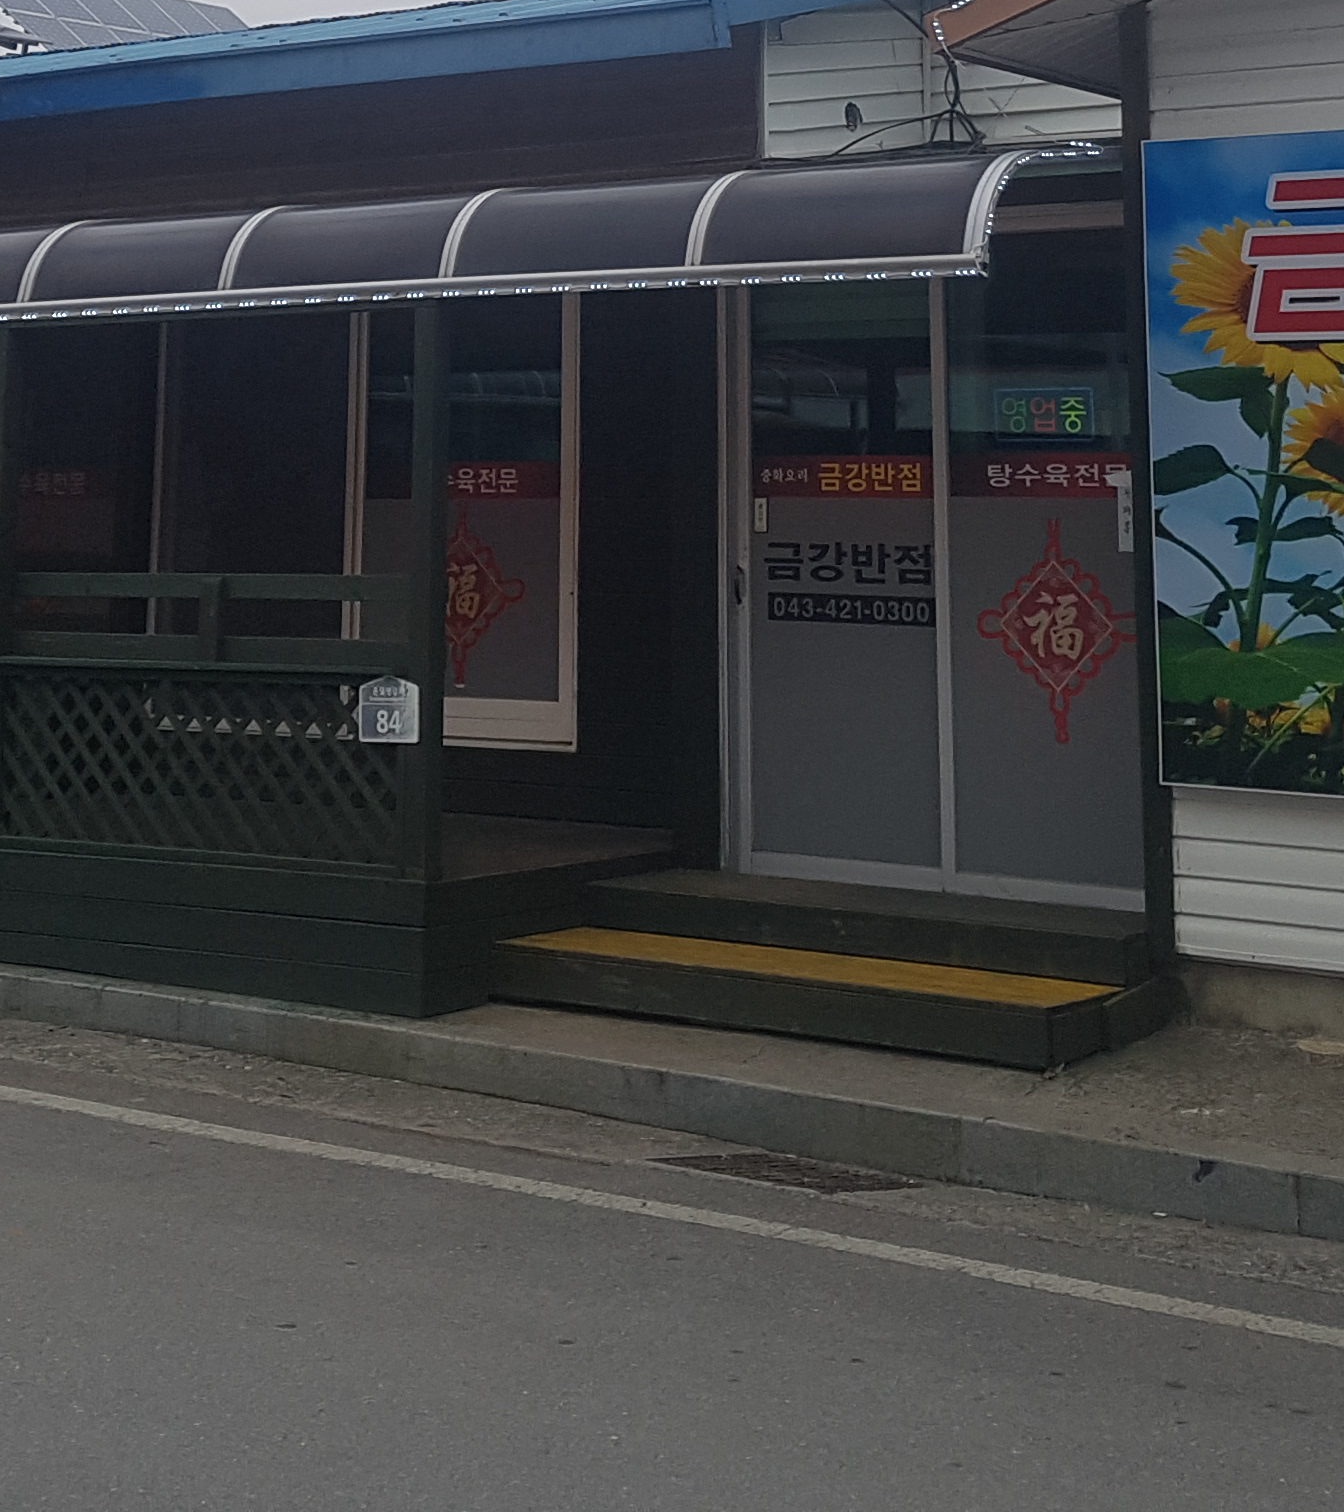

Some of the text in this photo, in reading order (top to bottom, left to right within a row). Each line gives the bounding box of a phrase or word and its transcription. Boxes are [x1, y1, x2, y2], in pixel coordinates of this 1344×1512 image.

[1001, 397, 1088, 434] 영업중
[19, 472, 86, 496] 수육전문
[447, 468, 518, 494] 육전문
[817, 462, 923, 492] 금강반점
[764, 542, 933, 586] 금강반점
[773, 597, 931, 623] 043-421-0300
[1023, 591, 1085, 662] 福
[376, 709, 402, 734] 84
